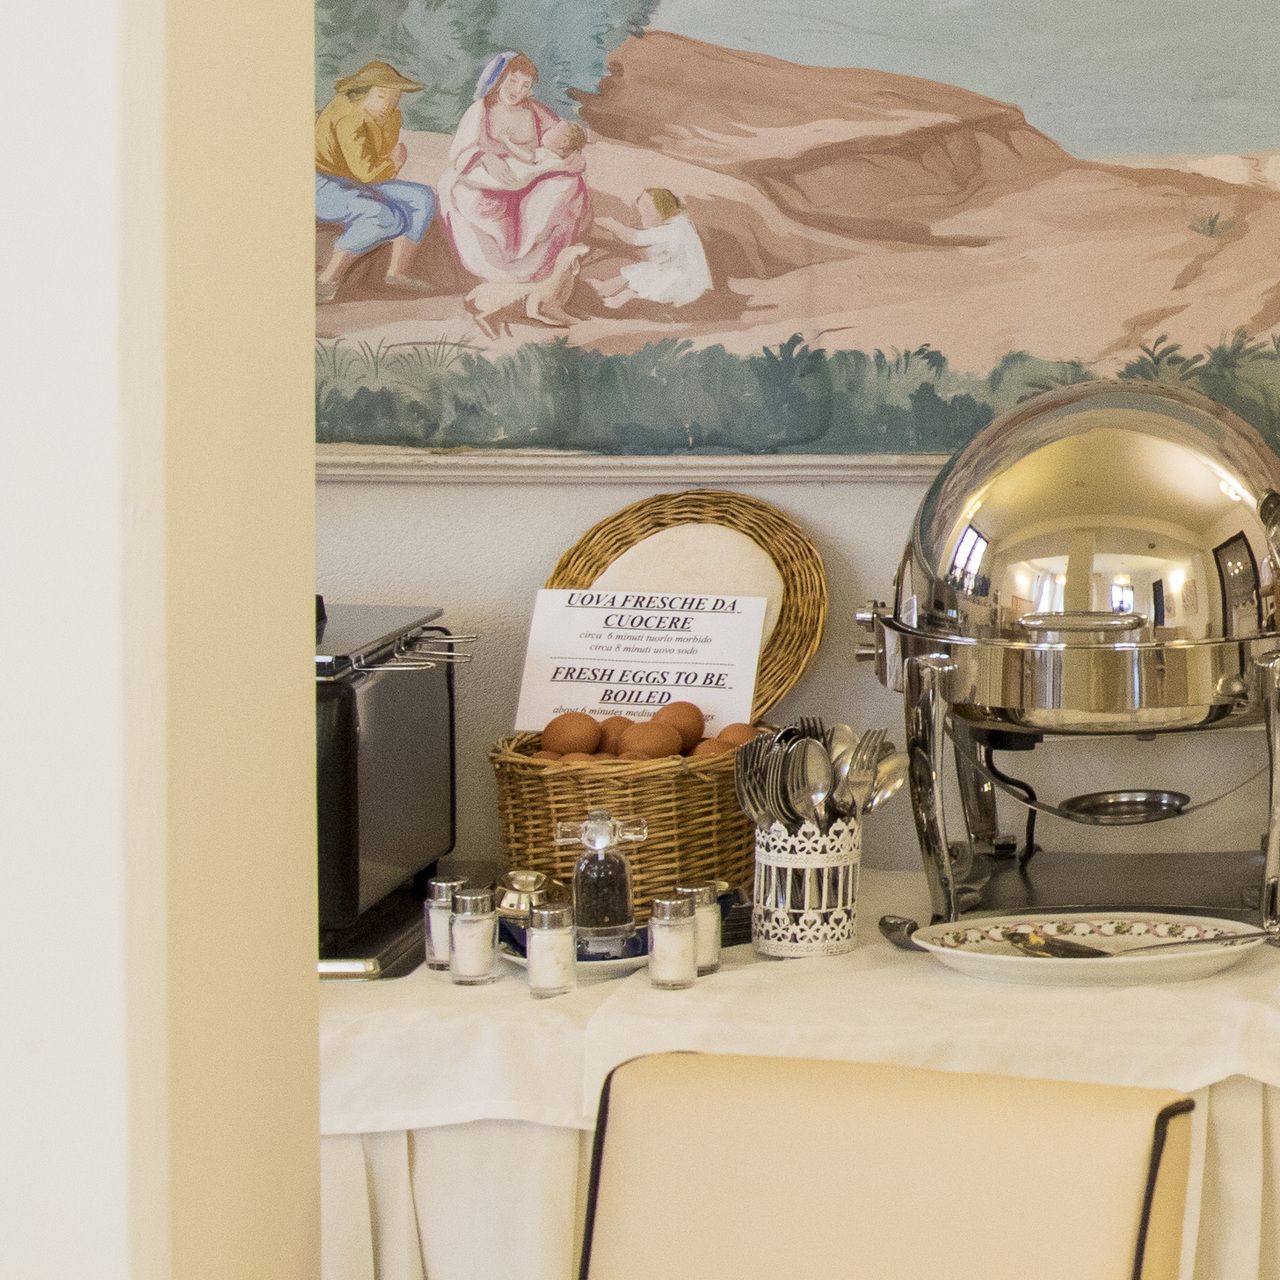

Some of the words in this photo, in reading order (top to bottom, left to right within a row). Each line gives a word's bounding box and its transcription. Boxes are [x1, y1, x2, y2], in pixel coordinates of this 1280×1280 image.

[566, 593, 617, 607] UOVA
[620, 595, 709, 611] FRESCHE
[711, 598, 738, 612] DA
[604, 613, 694, 630] CUOCERE
[579, 631, 602, 640] circa
[607, 632, 613, 640] 6
[615, 632, 645, 641] minuti
[646, 634, 673, 643] tuorlo
[674, 635, 712, 644] morbido
[589, 643, 613, 652] circa
[622, 645, 652, 654] minuti
[677, 646, 698, 655] sodo
[551, 666, 615, 682] FRESH
[618, 670, 670, 685] EGGS
[674, 671, 698, 685] TO
[702, 672, 729, 687] BE
[599, 688, 672, 704] BOILED
[588, 707, 623, 716] minutes
[625, 709, 655, 718] mediu
